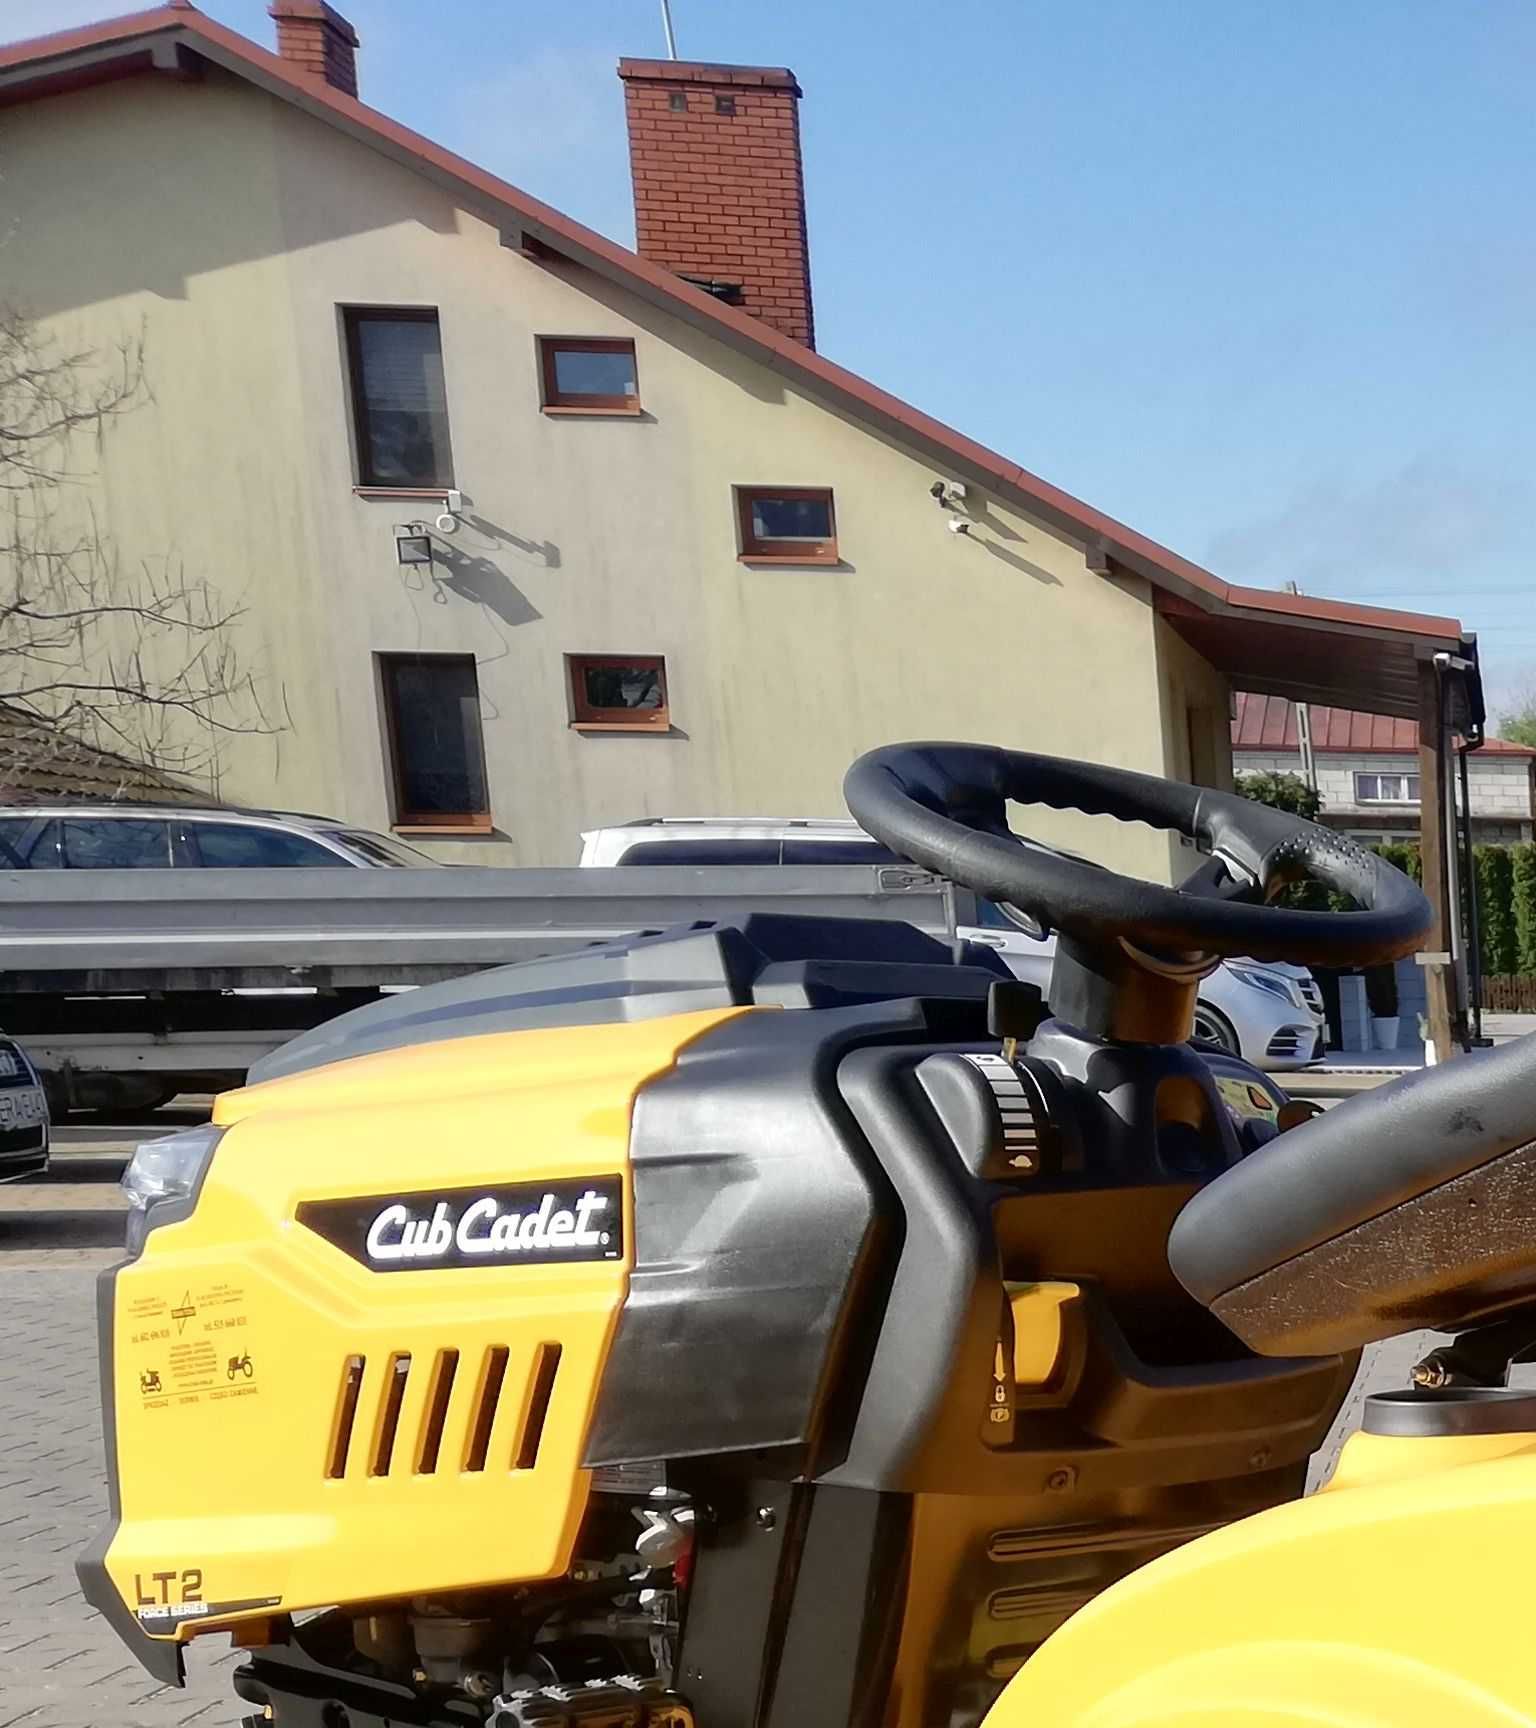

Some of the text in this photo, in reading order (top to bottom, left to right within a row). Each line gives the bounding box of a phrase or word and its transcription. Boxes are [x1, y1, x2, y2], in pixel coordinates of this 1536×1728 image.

[366, 1190, 608, 1260] Cub Cadet
[135, 1568, 203, 1606] LT2
[137, 1602, 209, 1620] FORCE SERIES
